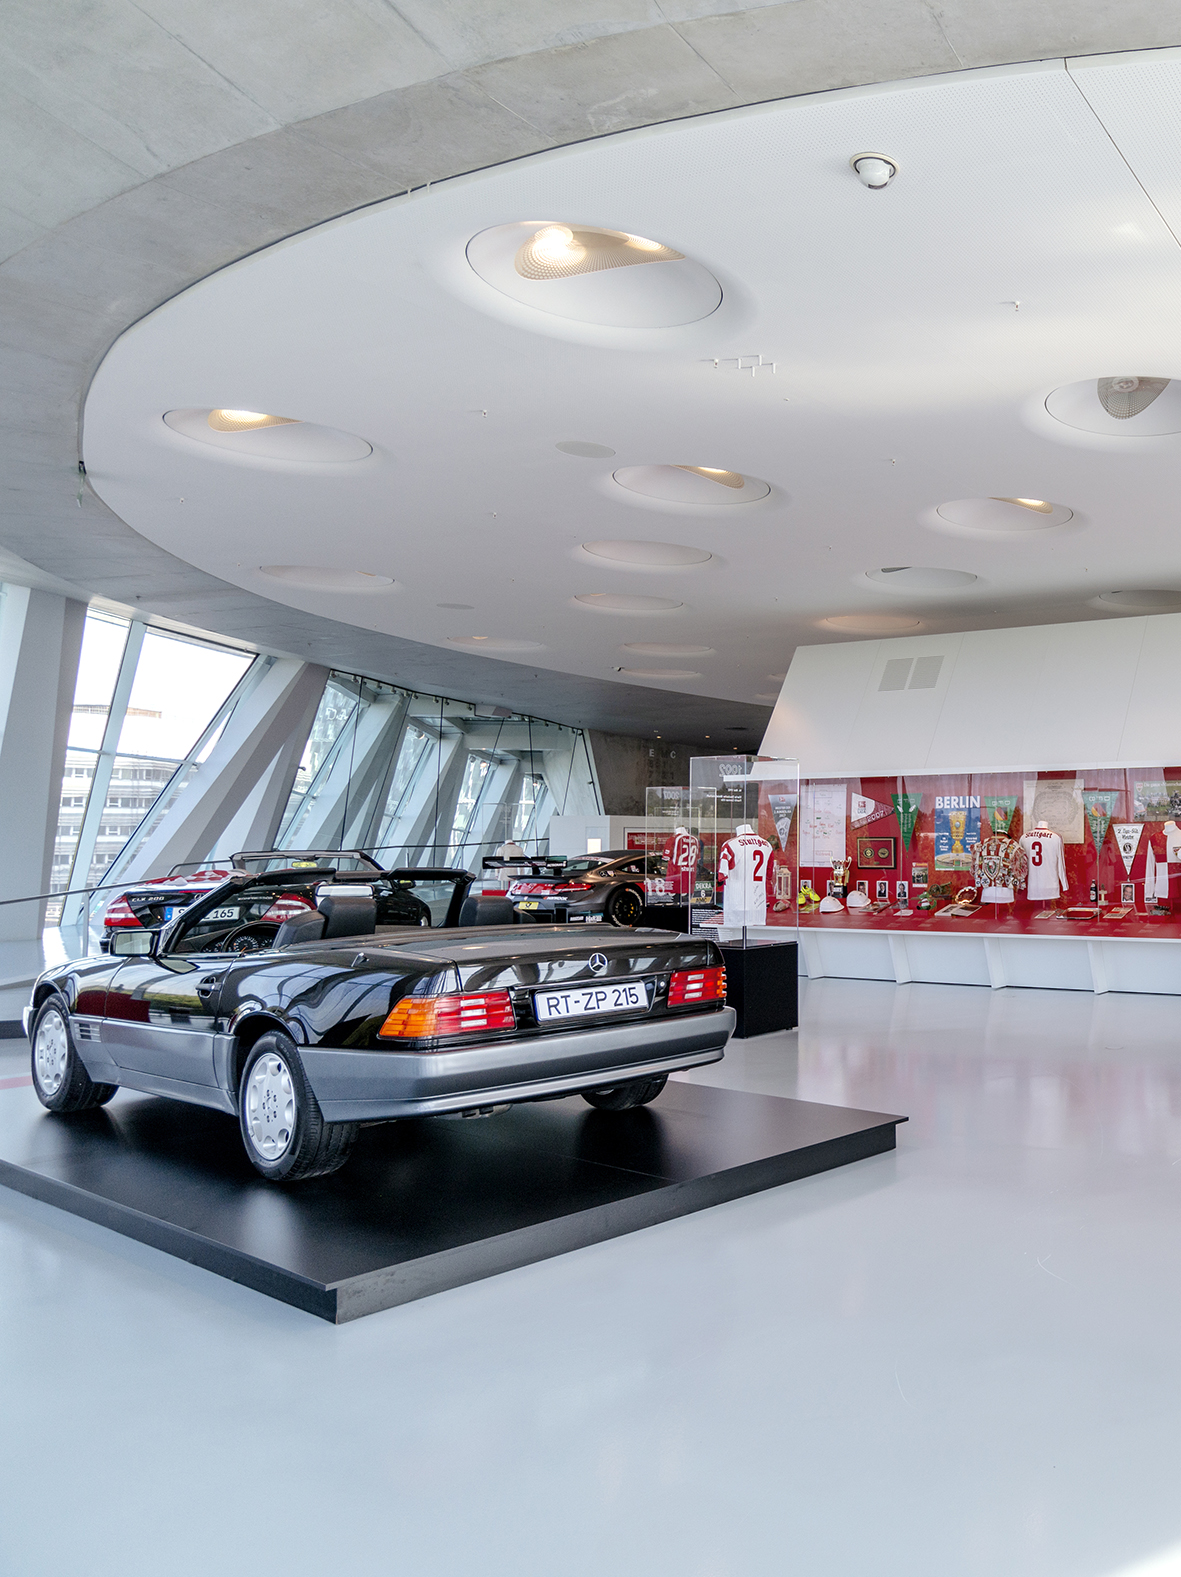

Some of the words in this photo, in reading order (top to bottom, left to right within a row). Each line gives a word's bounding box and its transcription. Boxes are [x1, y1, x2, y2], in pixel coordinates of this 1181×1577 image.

[935, 795, 981, 809] BERLIN
[866, 810, 884, 822] 2007
[1025, 831, 1053, 839] Stuttgart
[738, 839, 770, 848] Stuttgart
[677, 844, 698, 866] 28
[1031, 841, 1043, 867] 3
[752, 849, 764, 882] 2
[700, 889, 706, 898] 6
[213, 908, 234, 919] 165
[546, 991, 607, 1016] RT-ZP
[611, 987, 639, 1007] 215
